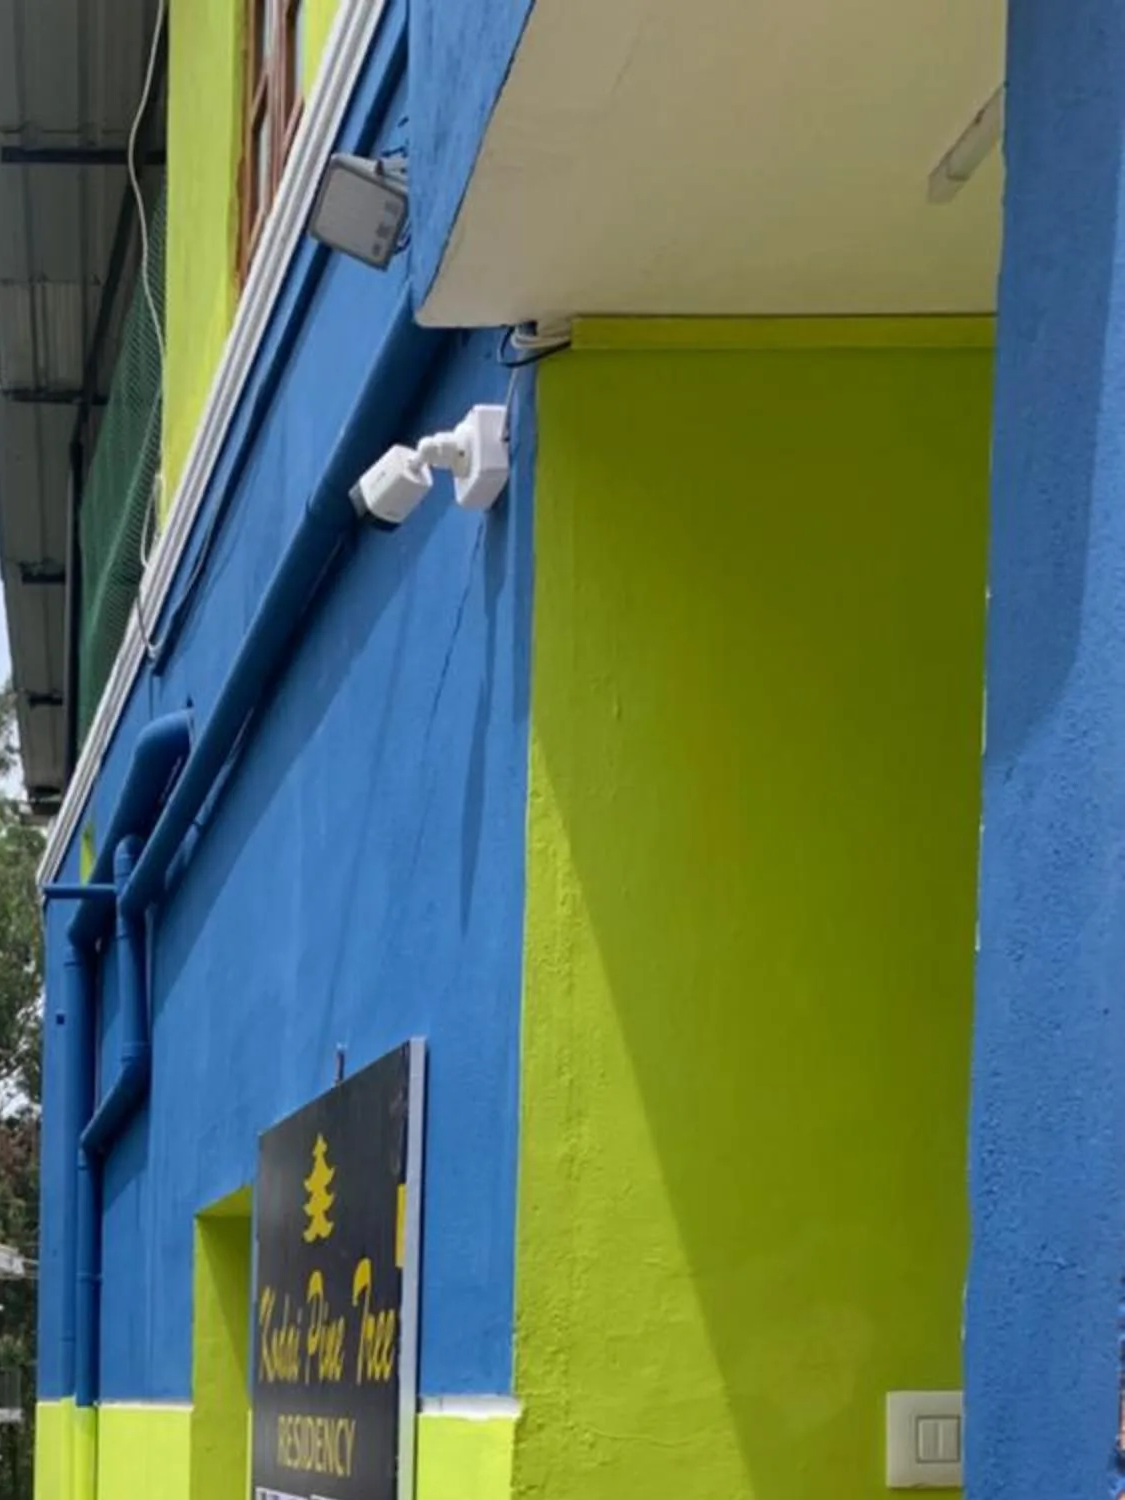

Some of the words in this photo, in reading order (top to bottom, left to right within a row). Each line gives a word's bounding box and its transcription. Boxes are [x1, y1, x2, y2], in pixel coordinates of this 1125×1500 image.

[306, 1270, 346, 1384] Pine
[352, 1257, 396, 1385] Tree
[278, 1414, 357, 1478] RESIDENCY
